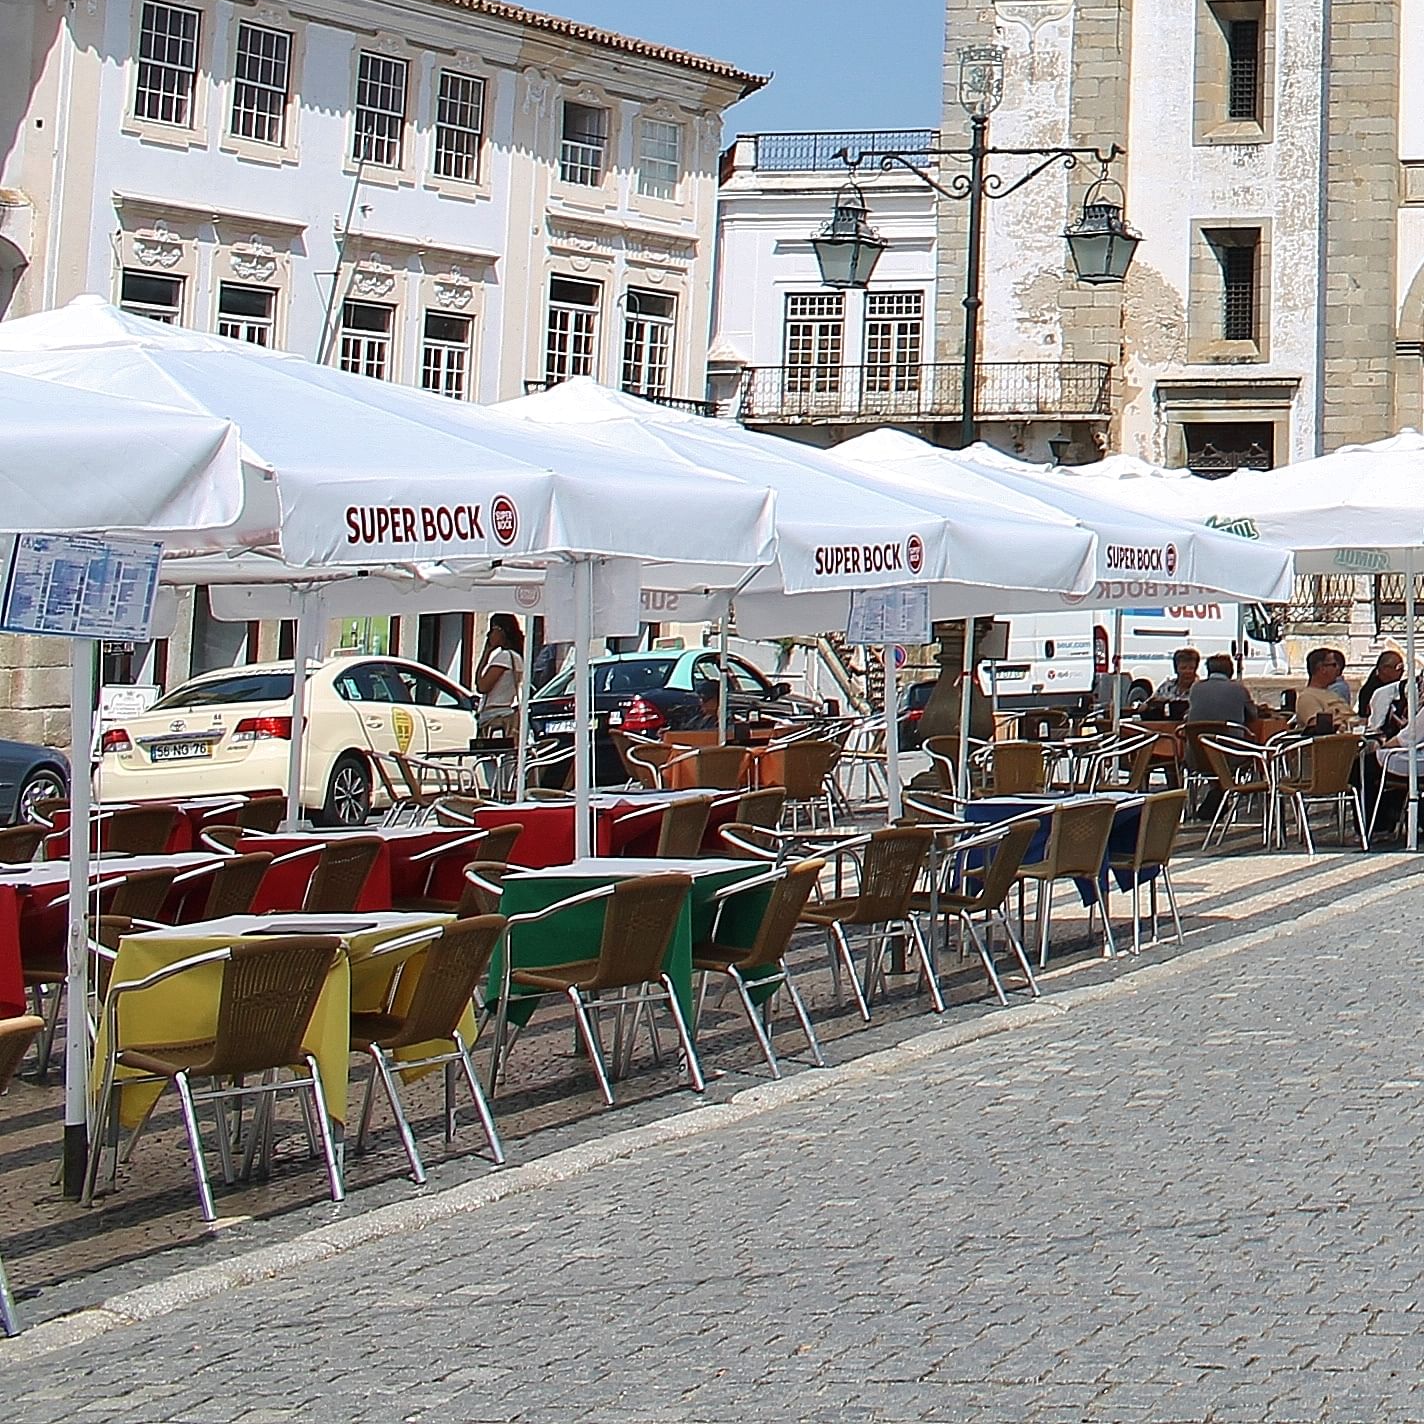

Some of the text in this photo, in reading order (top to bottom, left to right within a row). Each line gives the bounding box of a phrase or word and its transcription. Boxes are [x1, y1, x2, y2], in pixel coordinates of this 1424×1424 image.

[346, 505, 485, 544] SUPER BOCK
[815, 546, 861, 575] SUPER
[863, 543, 902, 573] BOCK
[1107, 545, 1136, 570] SUPER
[1137, 548, 1163, 571] BOCK
